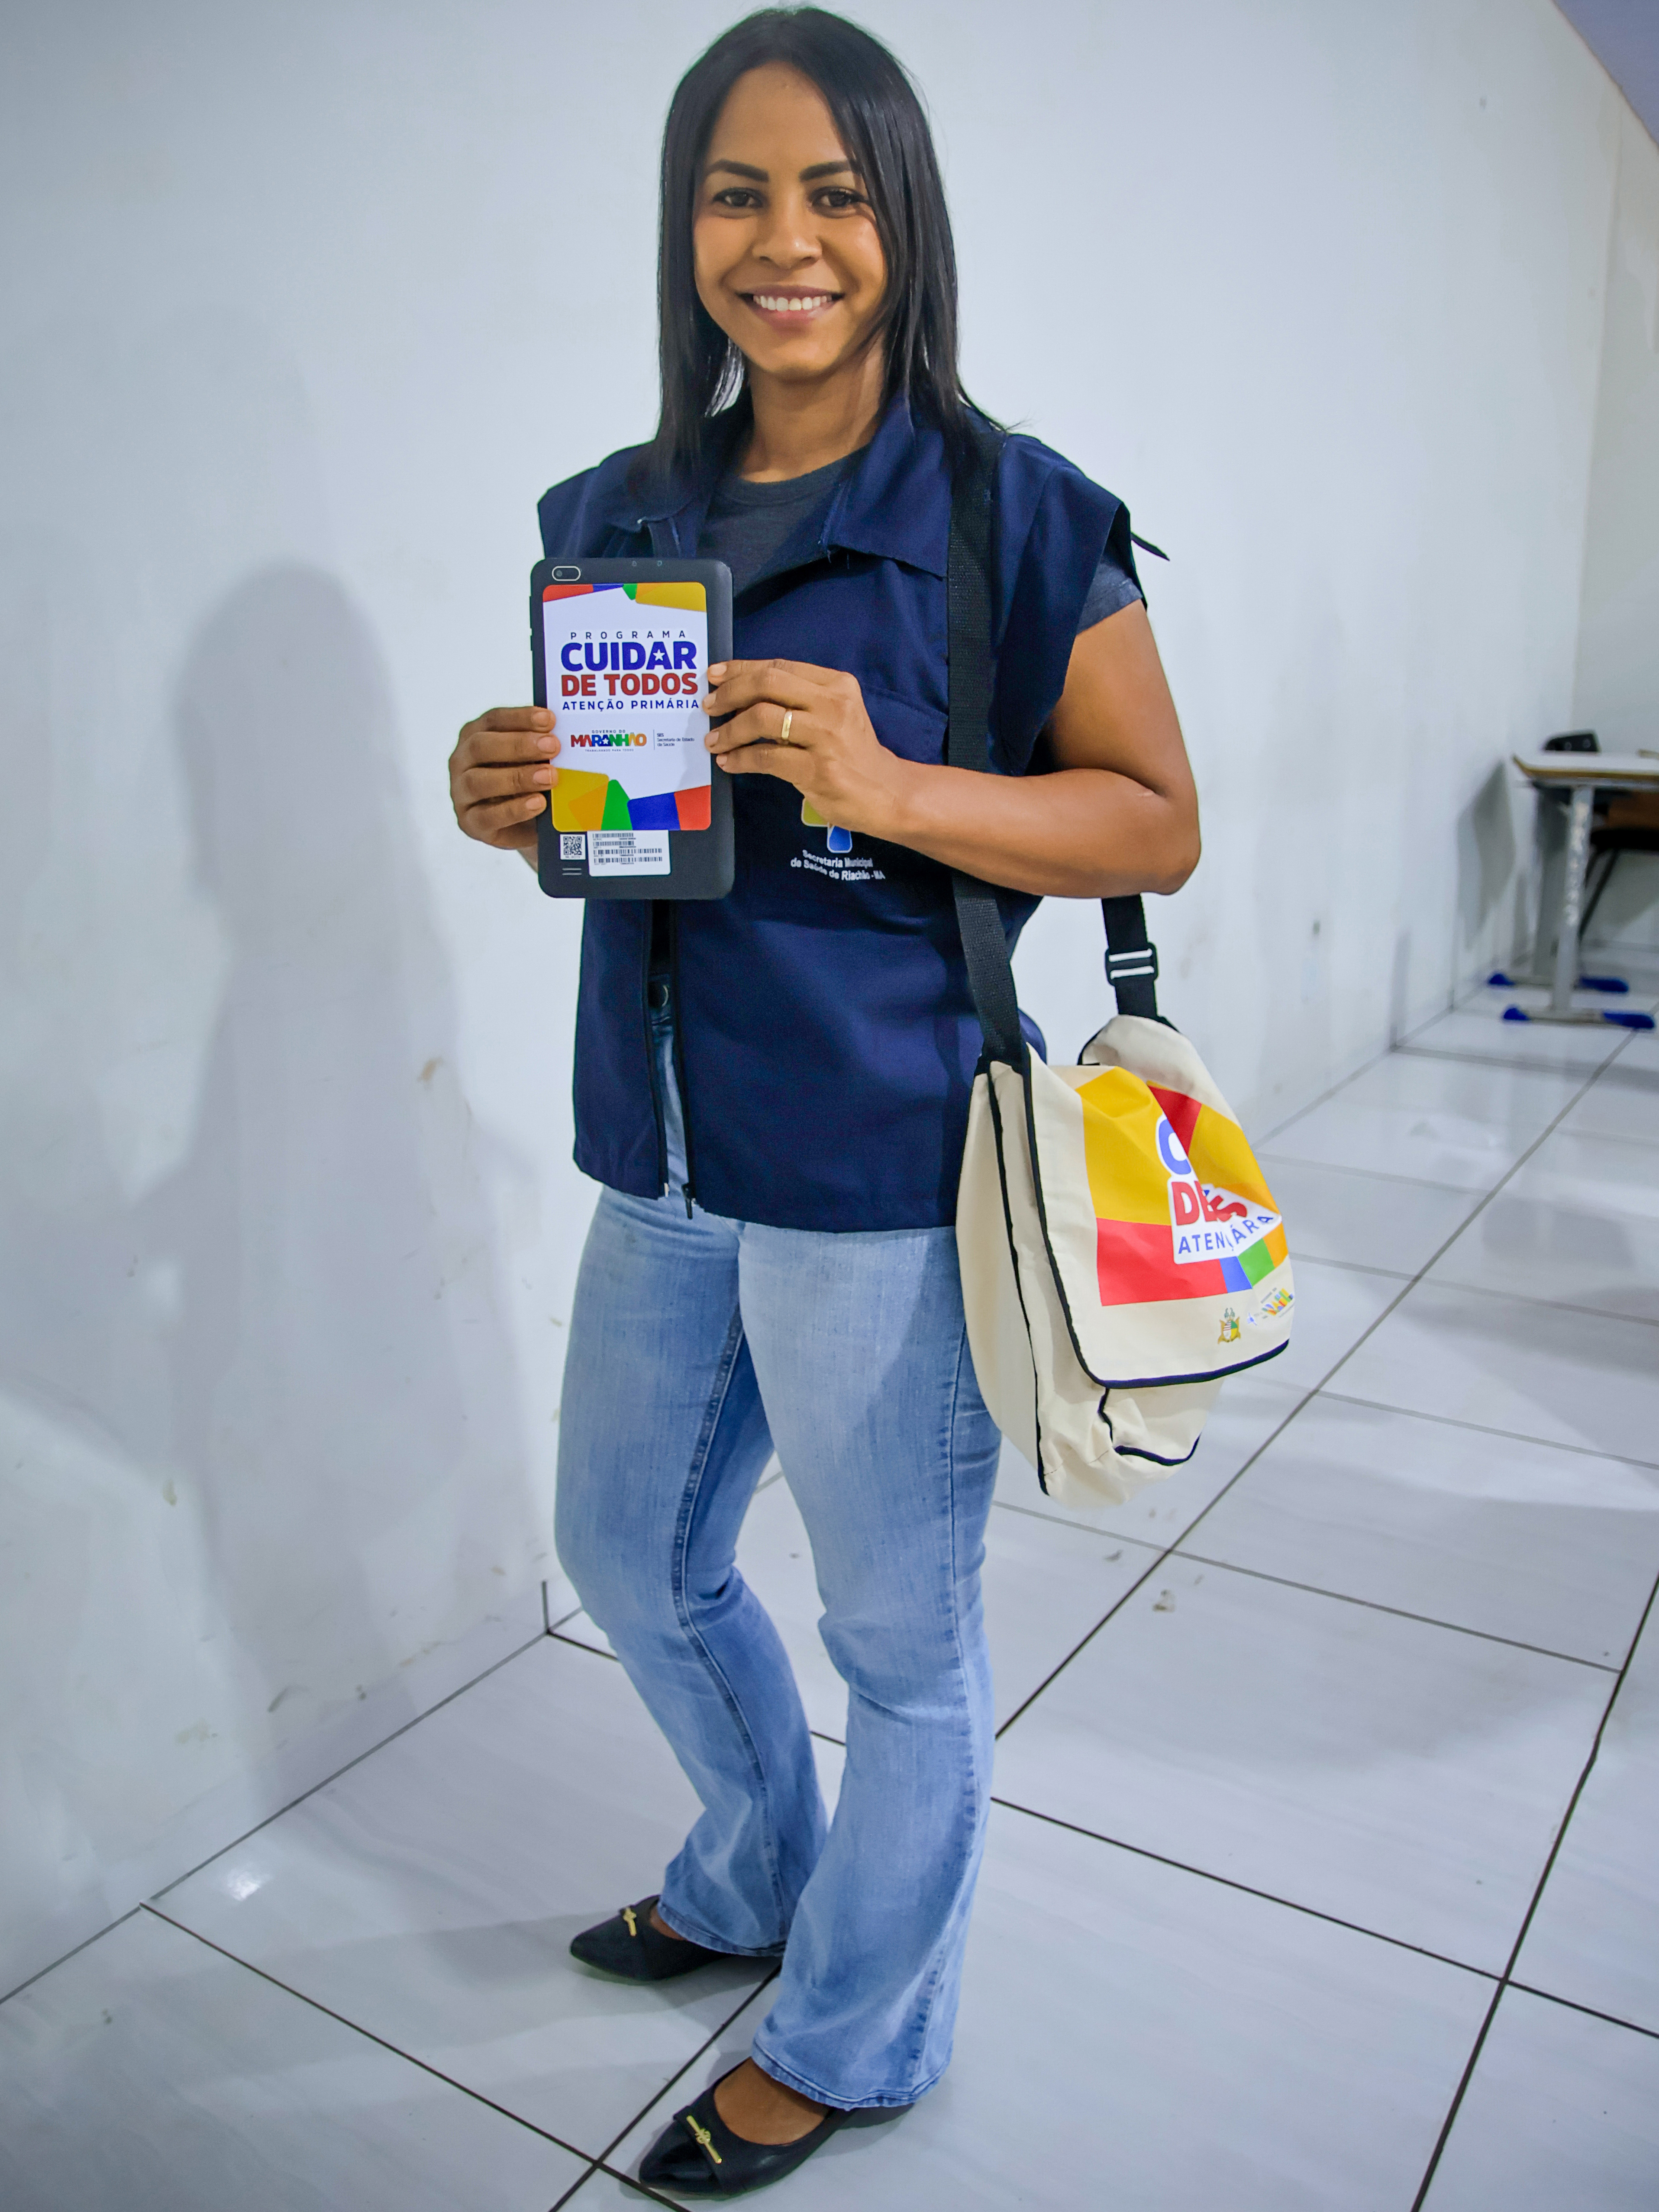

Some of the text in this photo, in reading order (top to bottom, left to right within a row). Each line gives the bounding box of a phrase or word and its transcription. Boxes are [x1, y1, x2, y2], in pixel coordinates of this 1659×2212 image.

[571, 630, 686, 639] PROGRAMA
[561, 641, 697, 671] CUIDAR
[562, 673, 698, 696] DE TODOS
[562, 698, 699, 711] ATENÇÃO PRIMÁRIA
[571, 732, 647, 747] MARANHÃO
[802, 849, 843, 867] Secretaria
